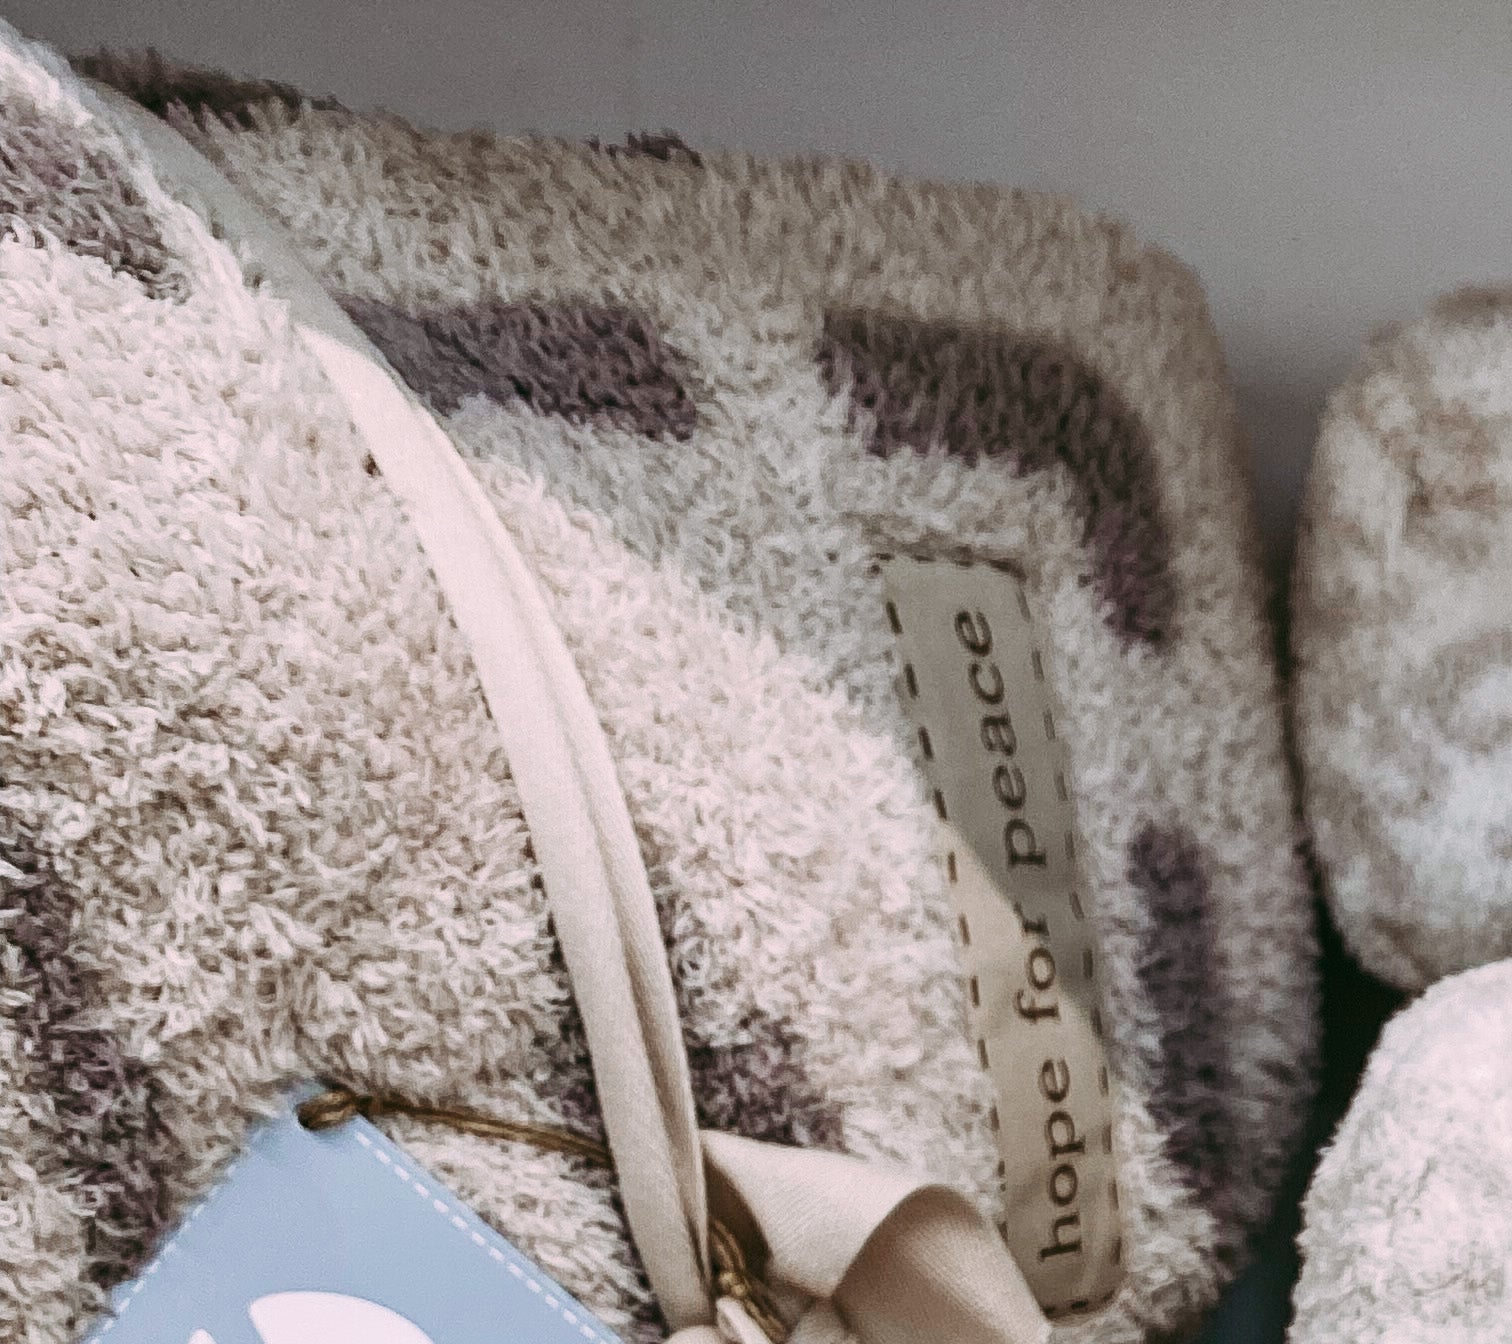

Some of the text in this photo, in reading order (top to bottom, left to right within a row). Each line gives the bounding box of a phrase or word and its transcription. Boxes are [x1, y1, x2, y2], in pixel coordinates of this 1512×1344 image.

[955, 609, 1086, 1263] hope for peace
